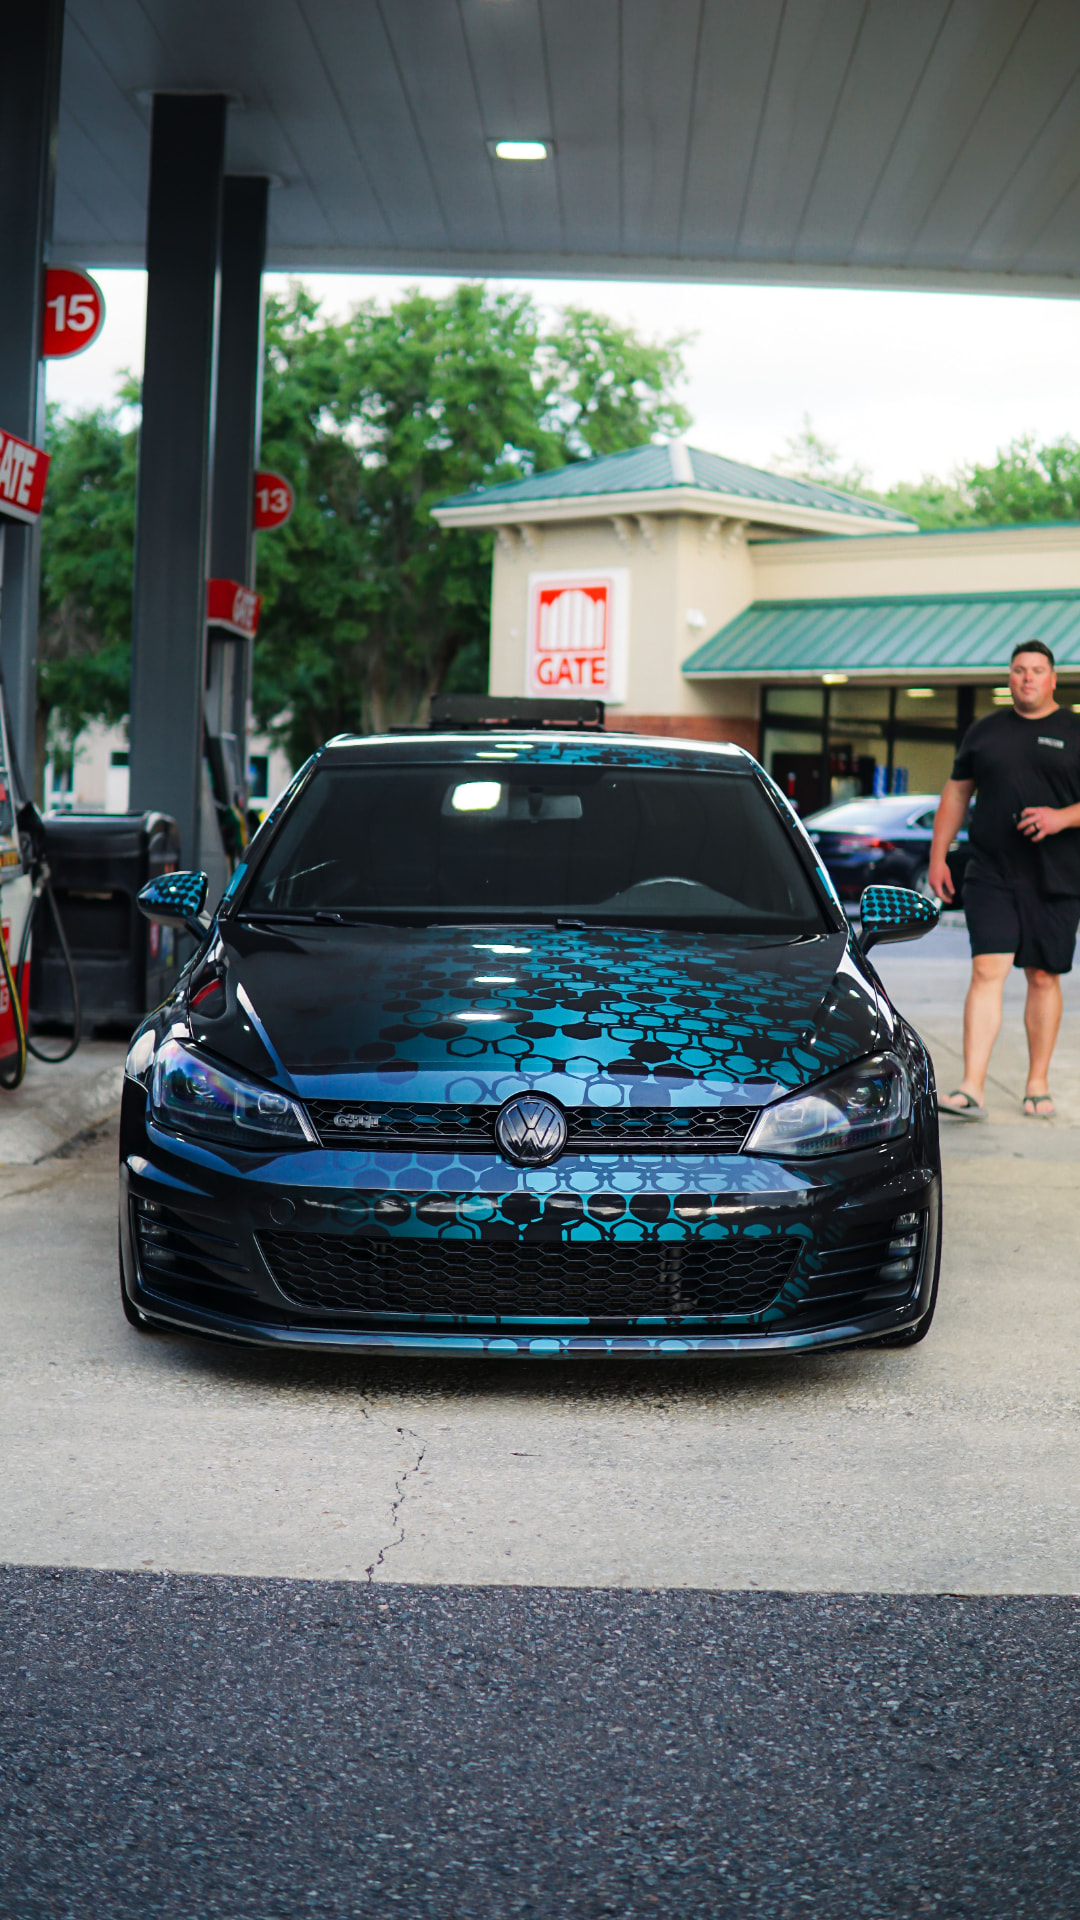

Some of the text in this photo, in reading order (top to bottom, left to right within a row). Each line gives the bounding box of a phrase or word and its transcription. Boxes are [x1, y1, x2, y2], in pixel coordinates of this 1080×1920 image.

[47, 294, 95, 332] 15
[0, 433, 37, 506] ATE
[256, 488, 287, 513] 13
[537, 657, 605, 685] GATE
